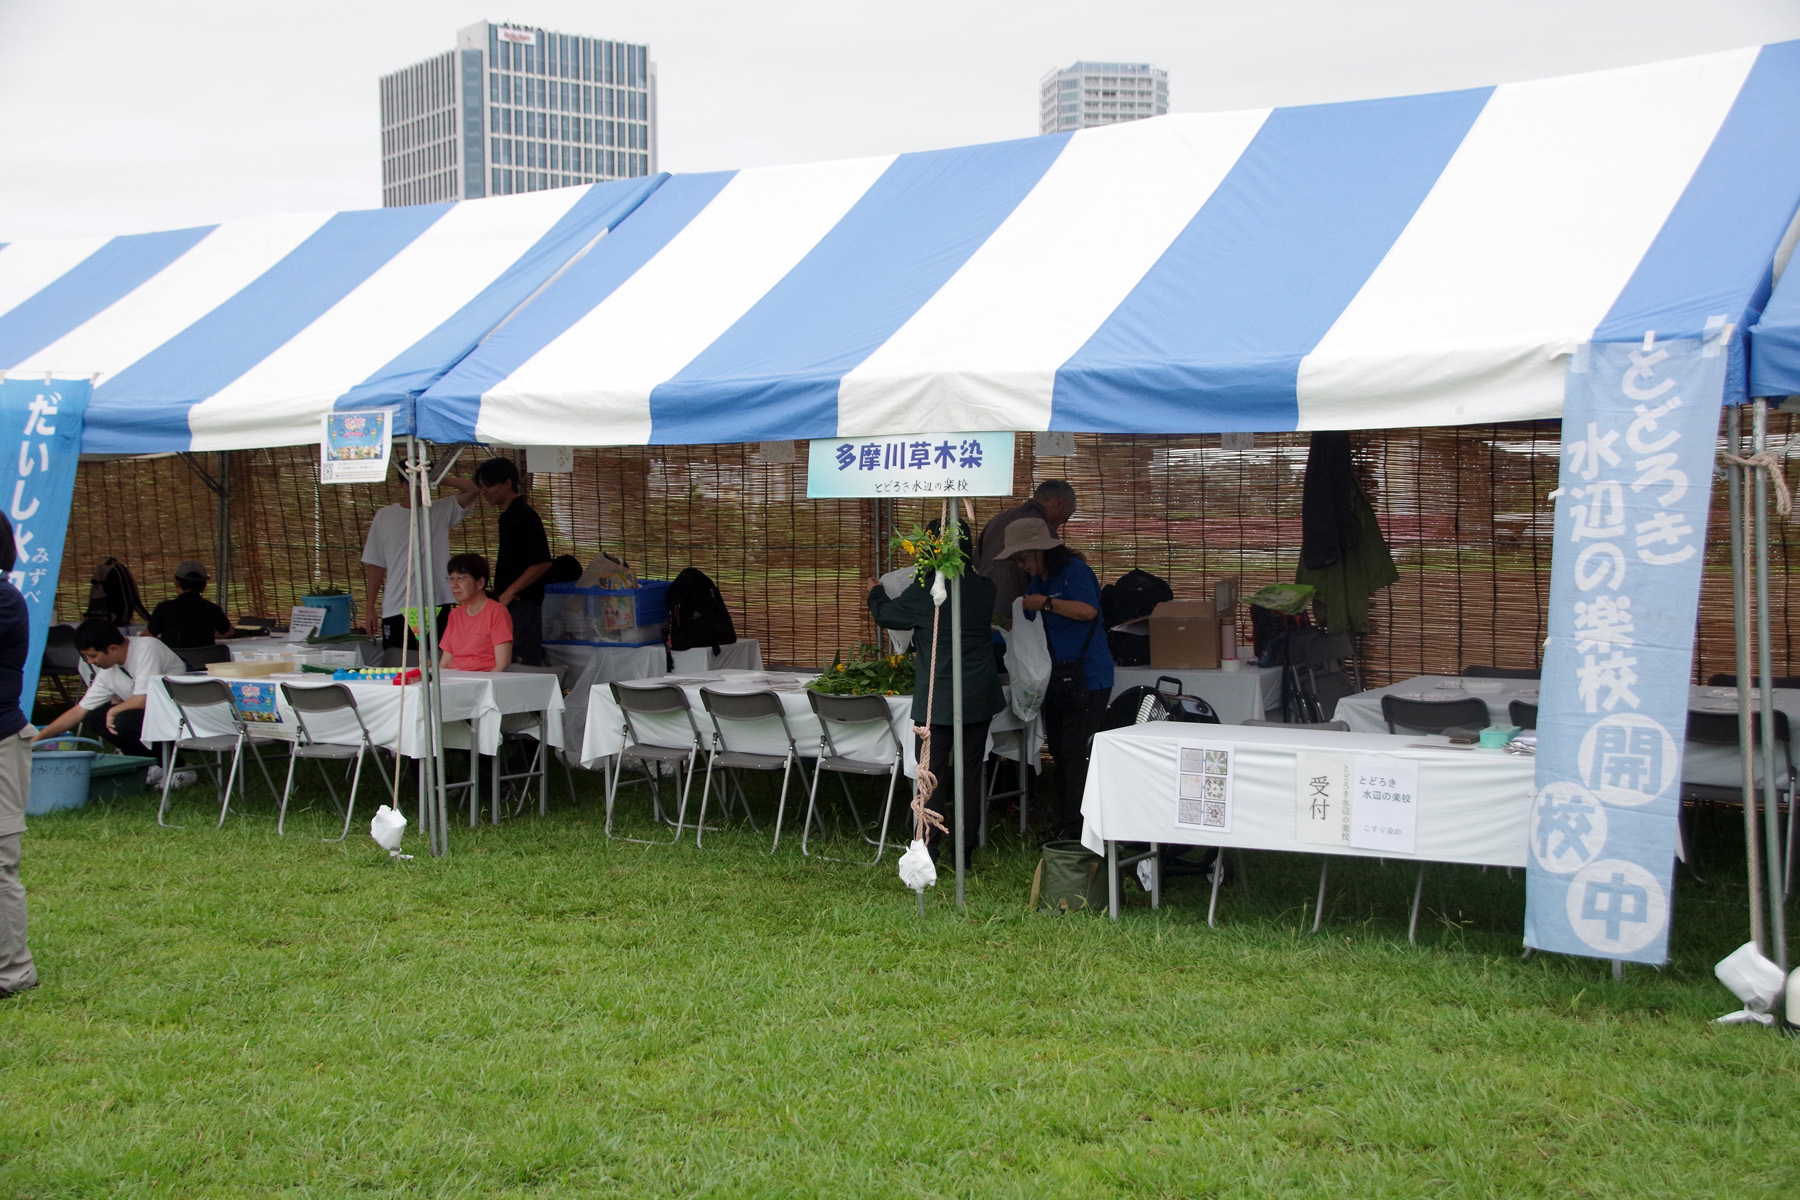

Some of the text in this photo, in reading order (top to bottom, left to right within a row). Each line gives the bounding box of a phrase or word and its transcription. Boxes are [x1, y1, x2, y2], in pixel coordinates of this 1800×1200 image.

[836, 439, 983, 471] 多摩川草木染
[1622, 349, 1697, 565] とどろき
[875, 478, 969, 493] とどろき水辺の楽校
[24, 547, 49, 603] みずべ
[1567, 422, 1640, 713] 水辺の楽校
[1309, 775, 1330, 821] 受付
[1341, 764, 1350, 841] とどろき水辺の楽校
[1359, 775, 1397, 788] とどろき
[1362, 789, 1411, 804] 水辺の楽校
